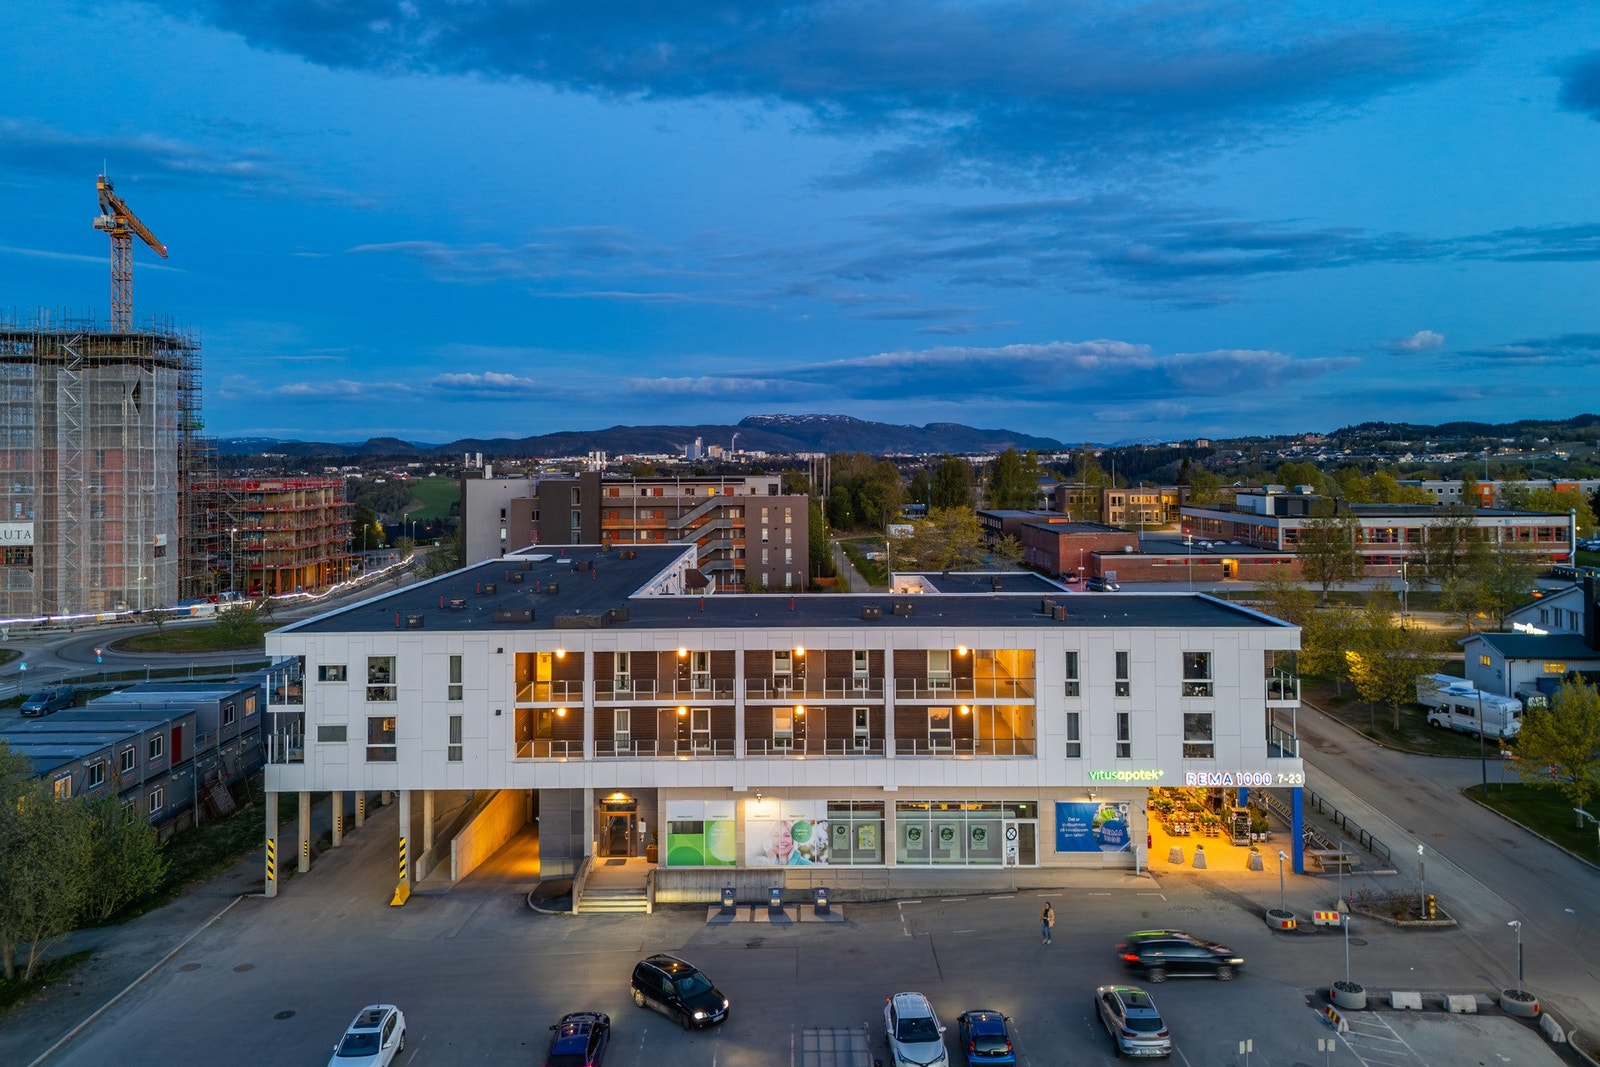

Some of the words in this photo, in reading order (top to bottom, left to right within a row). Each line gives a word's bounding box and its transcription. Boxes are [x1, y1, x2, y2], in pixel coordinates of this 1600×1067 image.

[0, 530, 32, 540] UTA
[1185, 772, 1234, 786] REMA
[1235, 772, 1273, 786] 1000
[1277, 773, 1303, 785] 7-23
